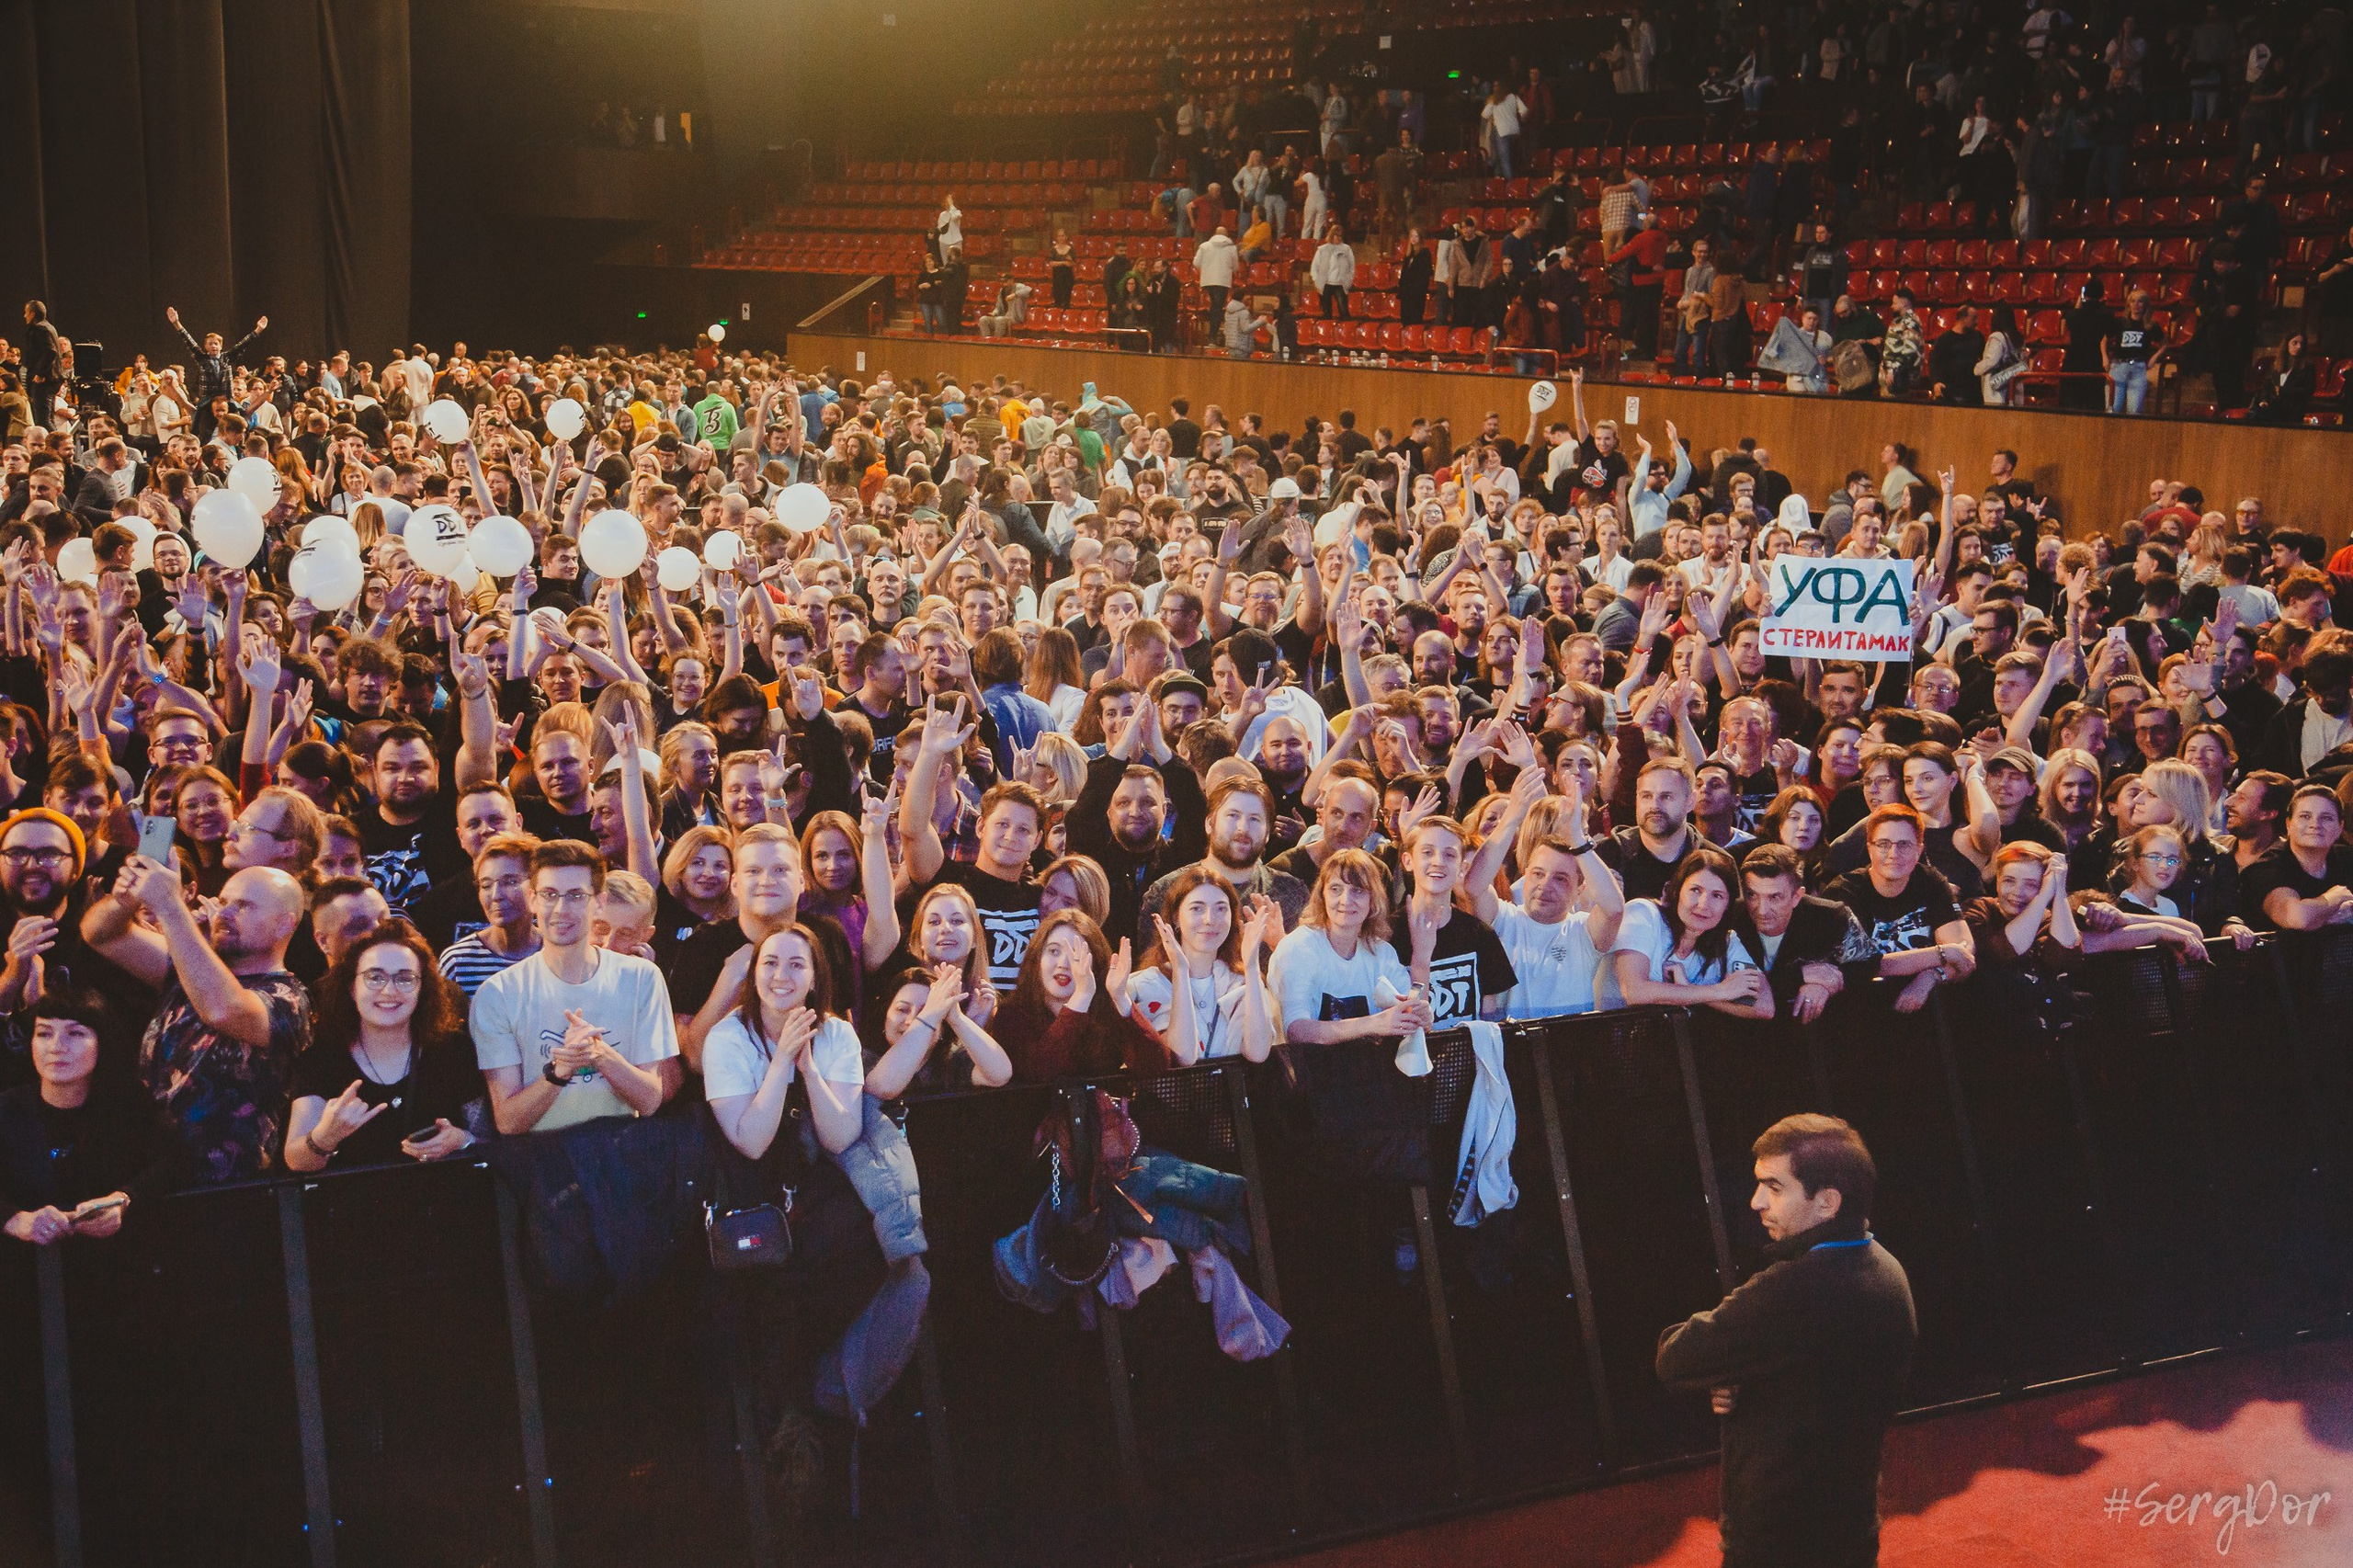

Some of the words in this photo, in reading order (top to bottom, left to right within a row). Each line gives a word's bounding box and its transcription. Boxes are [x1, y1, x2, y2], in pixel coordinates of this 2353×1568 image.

[1774, 563, 1911, 626] УФА
[1763, 628, 1911, 653] СТЕРЛИТАМАК
[993, 930, 1034, 965] DD
